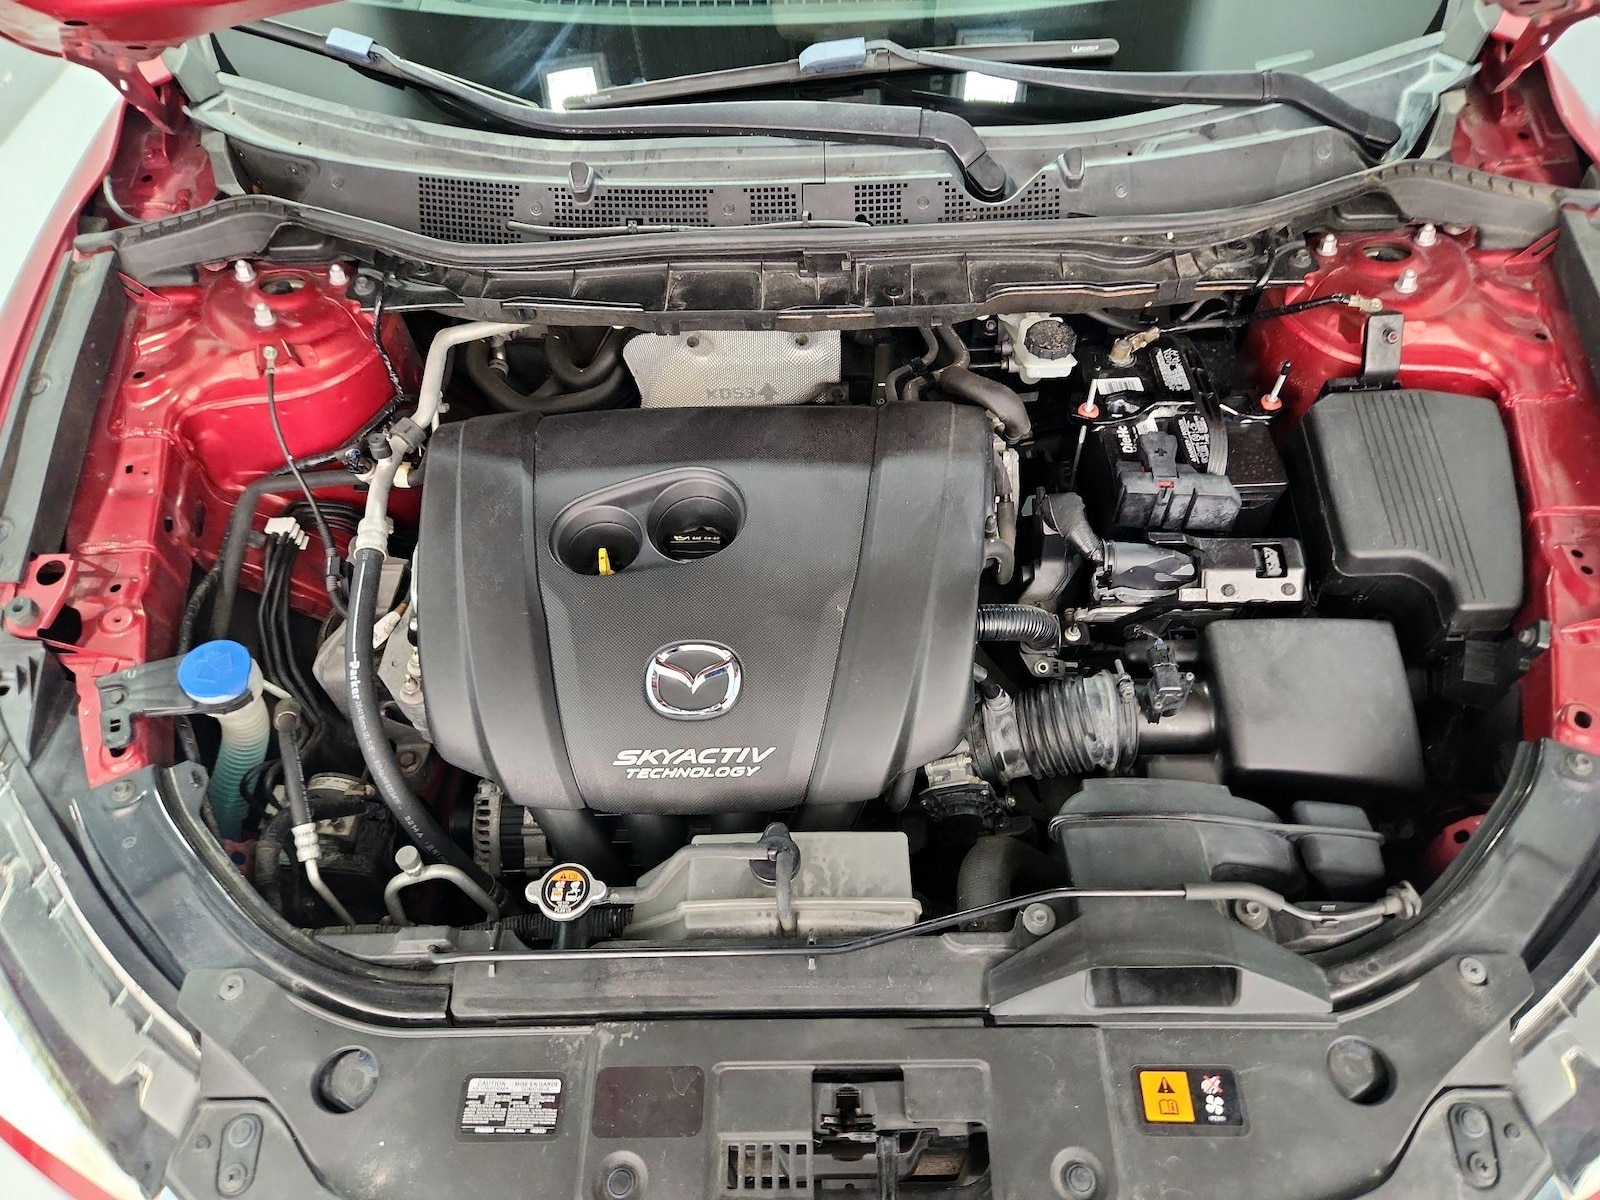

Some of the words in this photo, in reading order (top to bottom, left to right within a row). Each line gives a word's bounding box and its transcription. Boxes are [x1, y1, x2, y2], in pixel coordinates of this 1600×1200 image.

[349, 660, 360, 700] Parker
[612, 746, 777, 766] SKYACTIV
[626, 766, 761, 779] TECHNOLOGY
